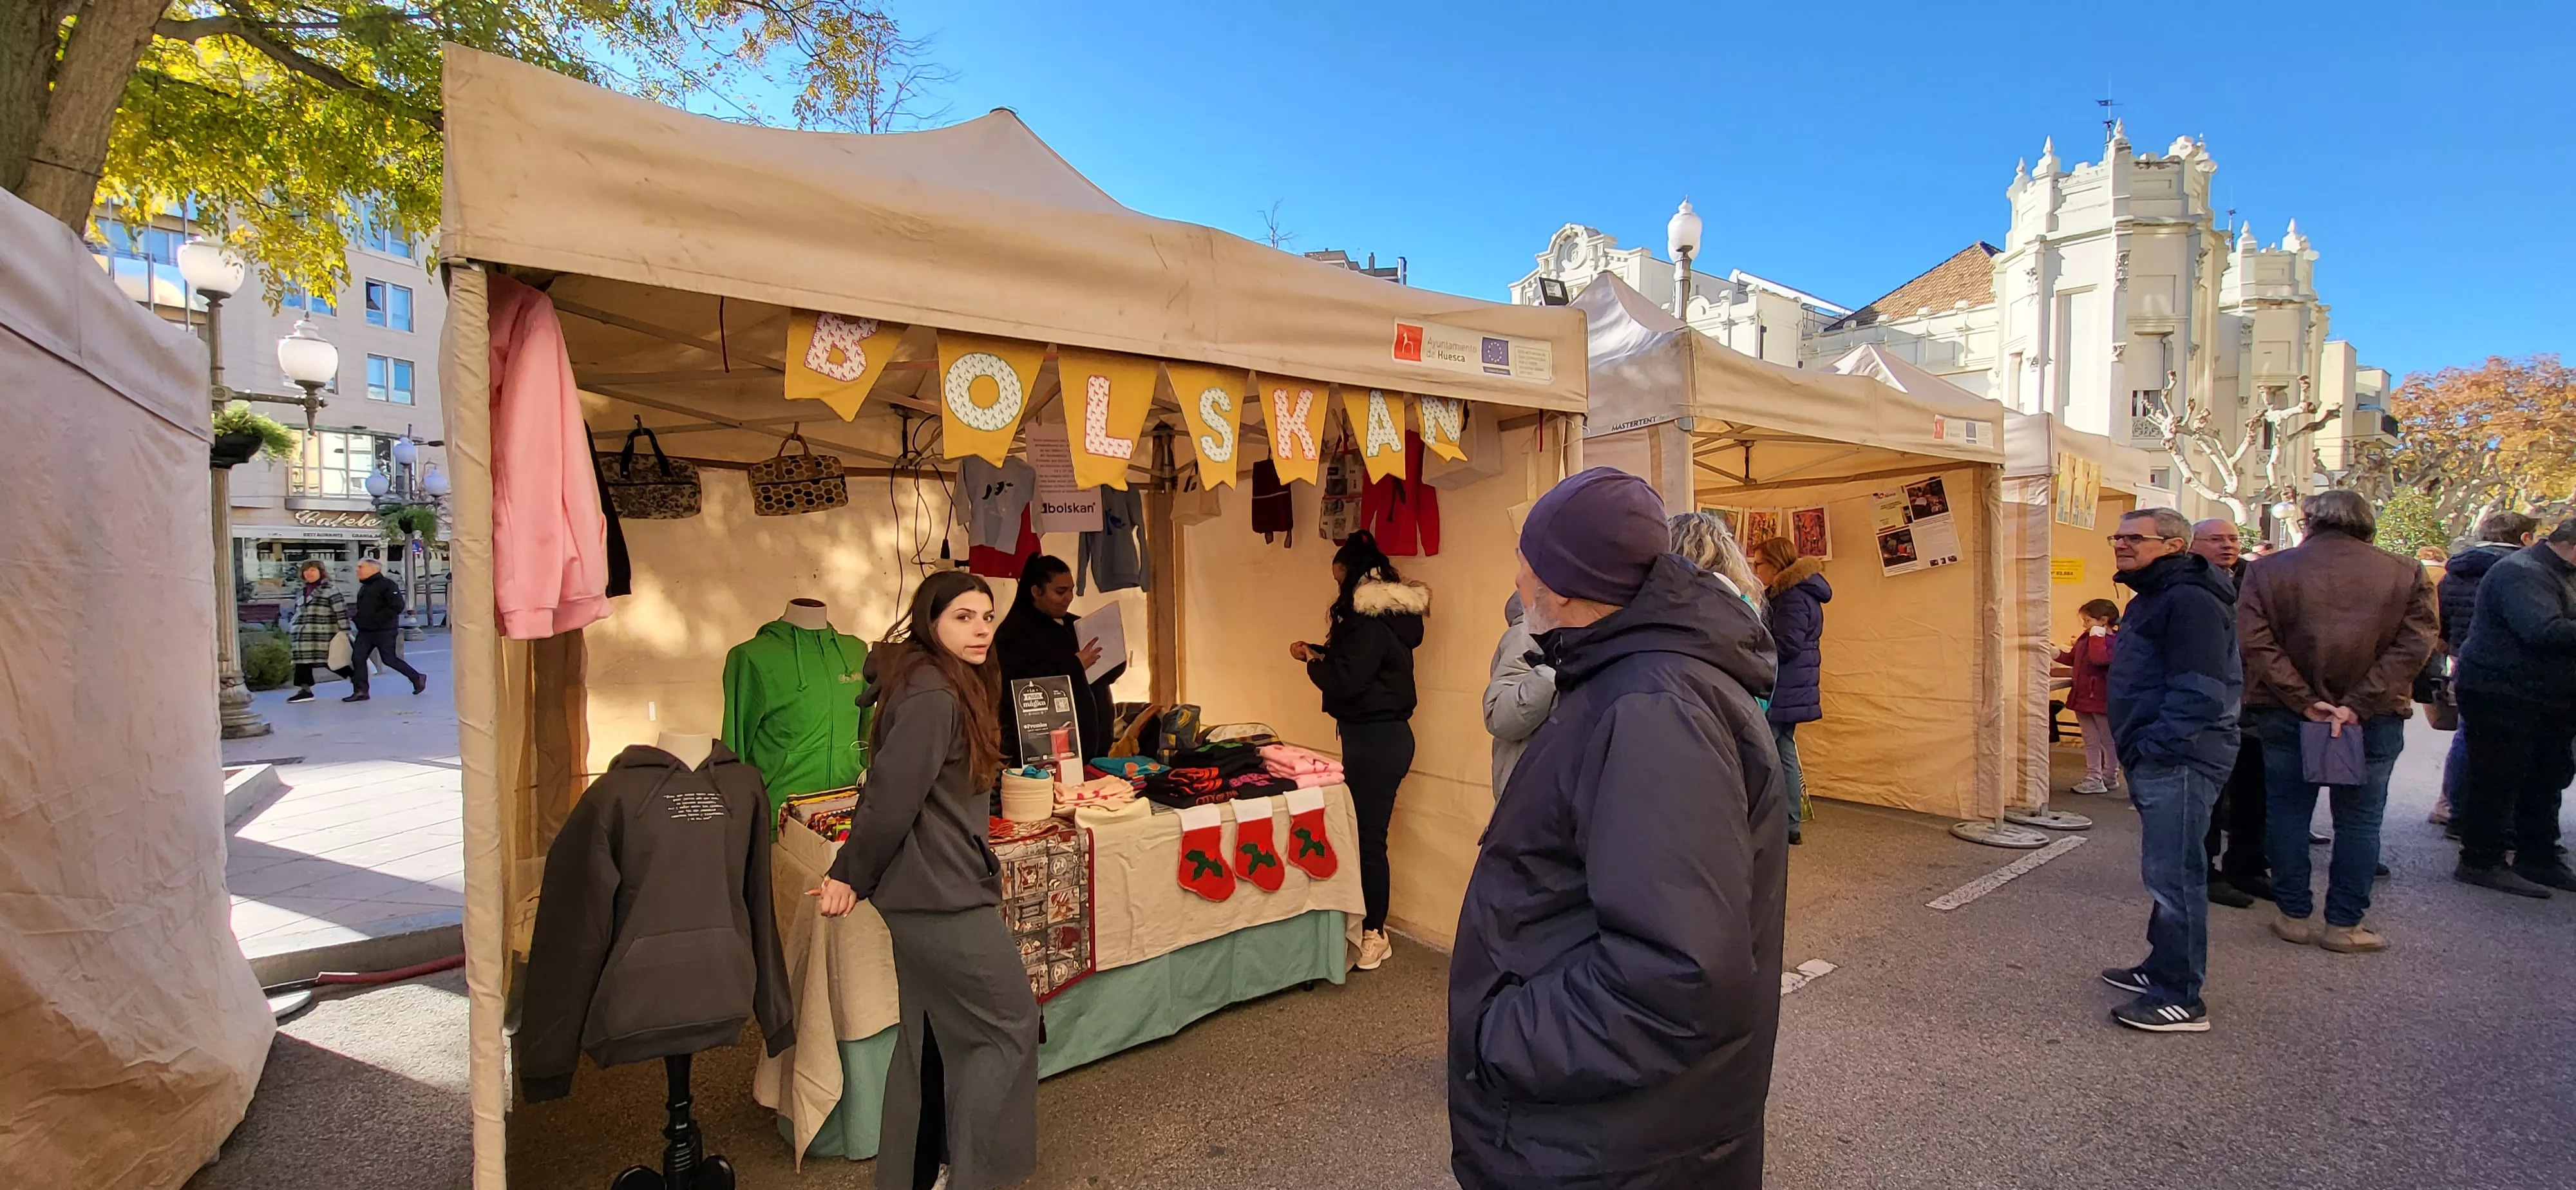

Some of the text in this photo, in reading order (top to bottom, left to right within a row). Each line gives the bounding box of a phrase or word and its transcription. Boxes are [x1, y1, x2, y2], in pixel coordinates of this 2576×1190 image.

[1427, 336, 1477, 354] Ayuntamiento
[1426, 350, 1466, 363] de Huesca
[1611, 416, 1657, 431] MASTERTENT
[1048, 502, 1094, 513] bolskan
